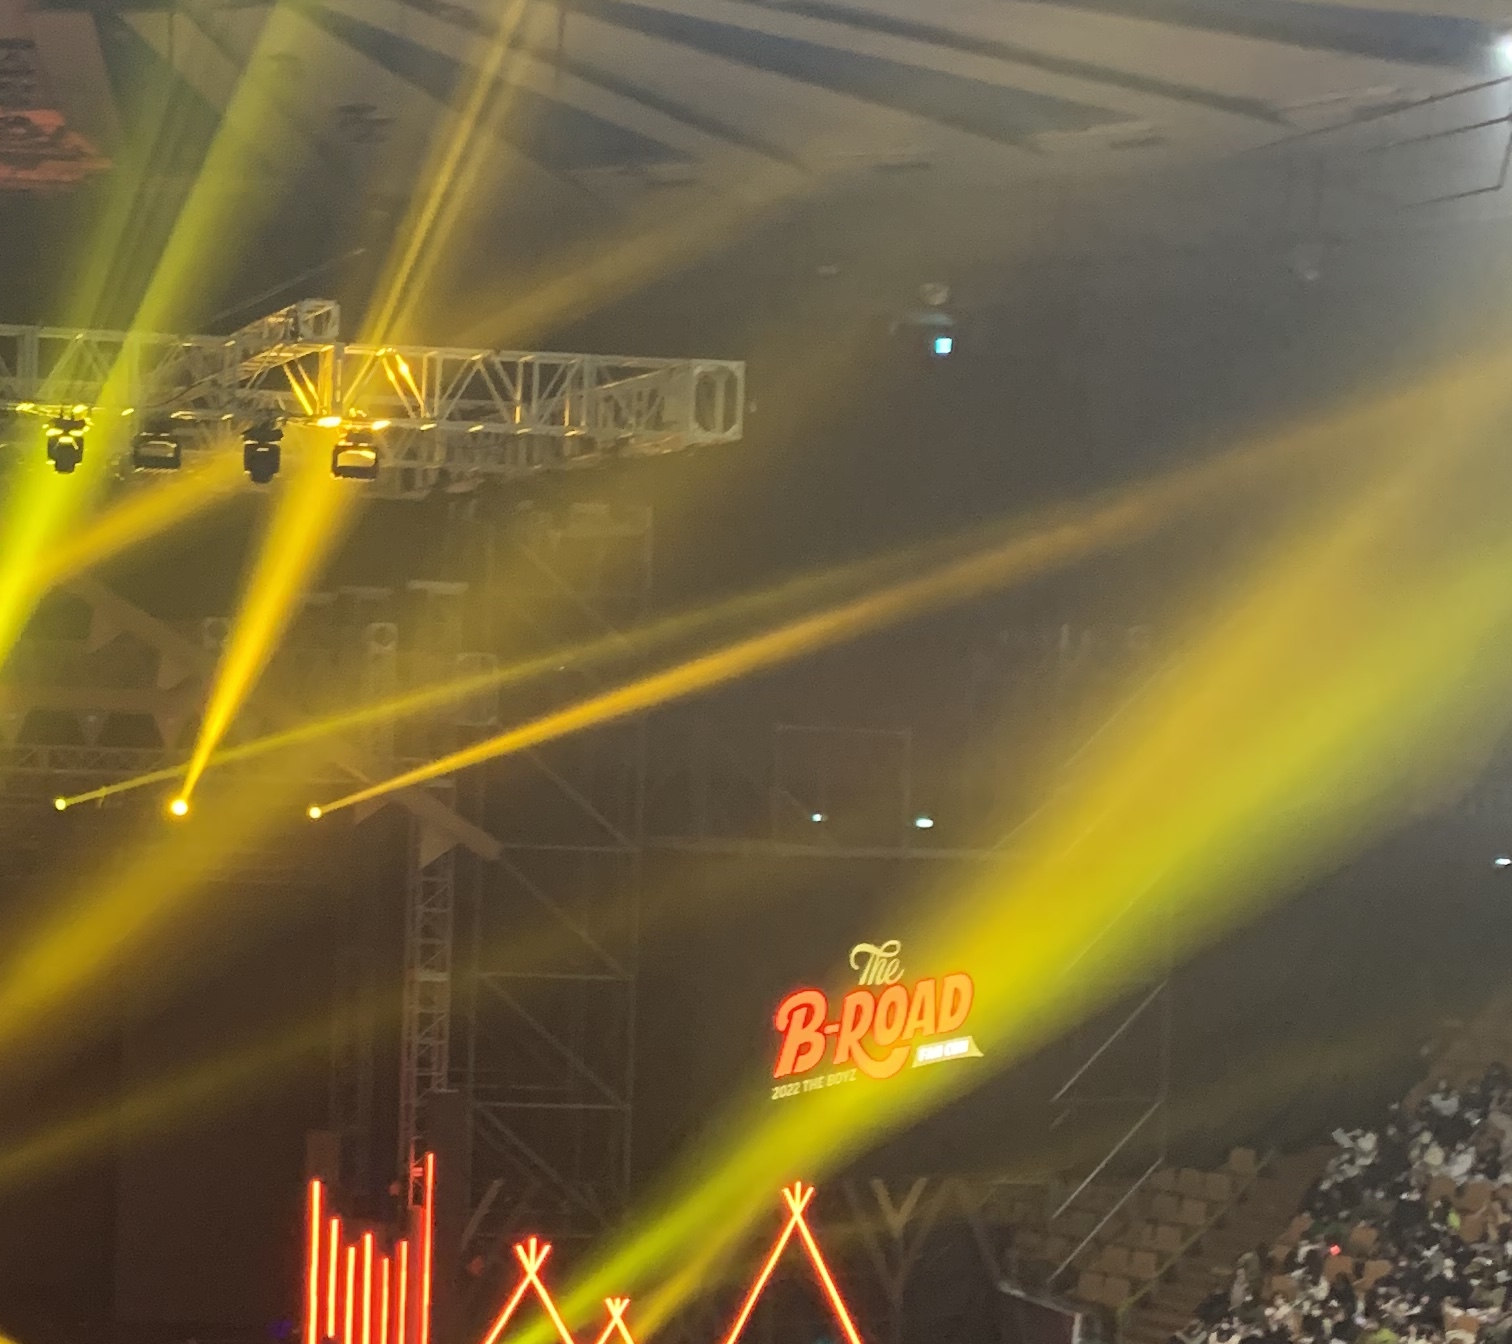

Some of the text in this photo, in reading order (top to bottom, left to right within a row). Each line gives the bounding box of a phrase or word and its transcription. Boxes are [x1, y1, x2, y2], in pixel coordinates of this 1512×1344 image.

[849, 939, 904, 985] The
[773, 972, 974, 1080] B-ROAD
[771, 1082, 800, 1100] 2022
[803, 1075, 824, 1093] THE
